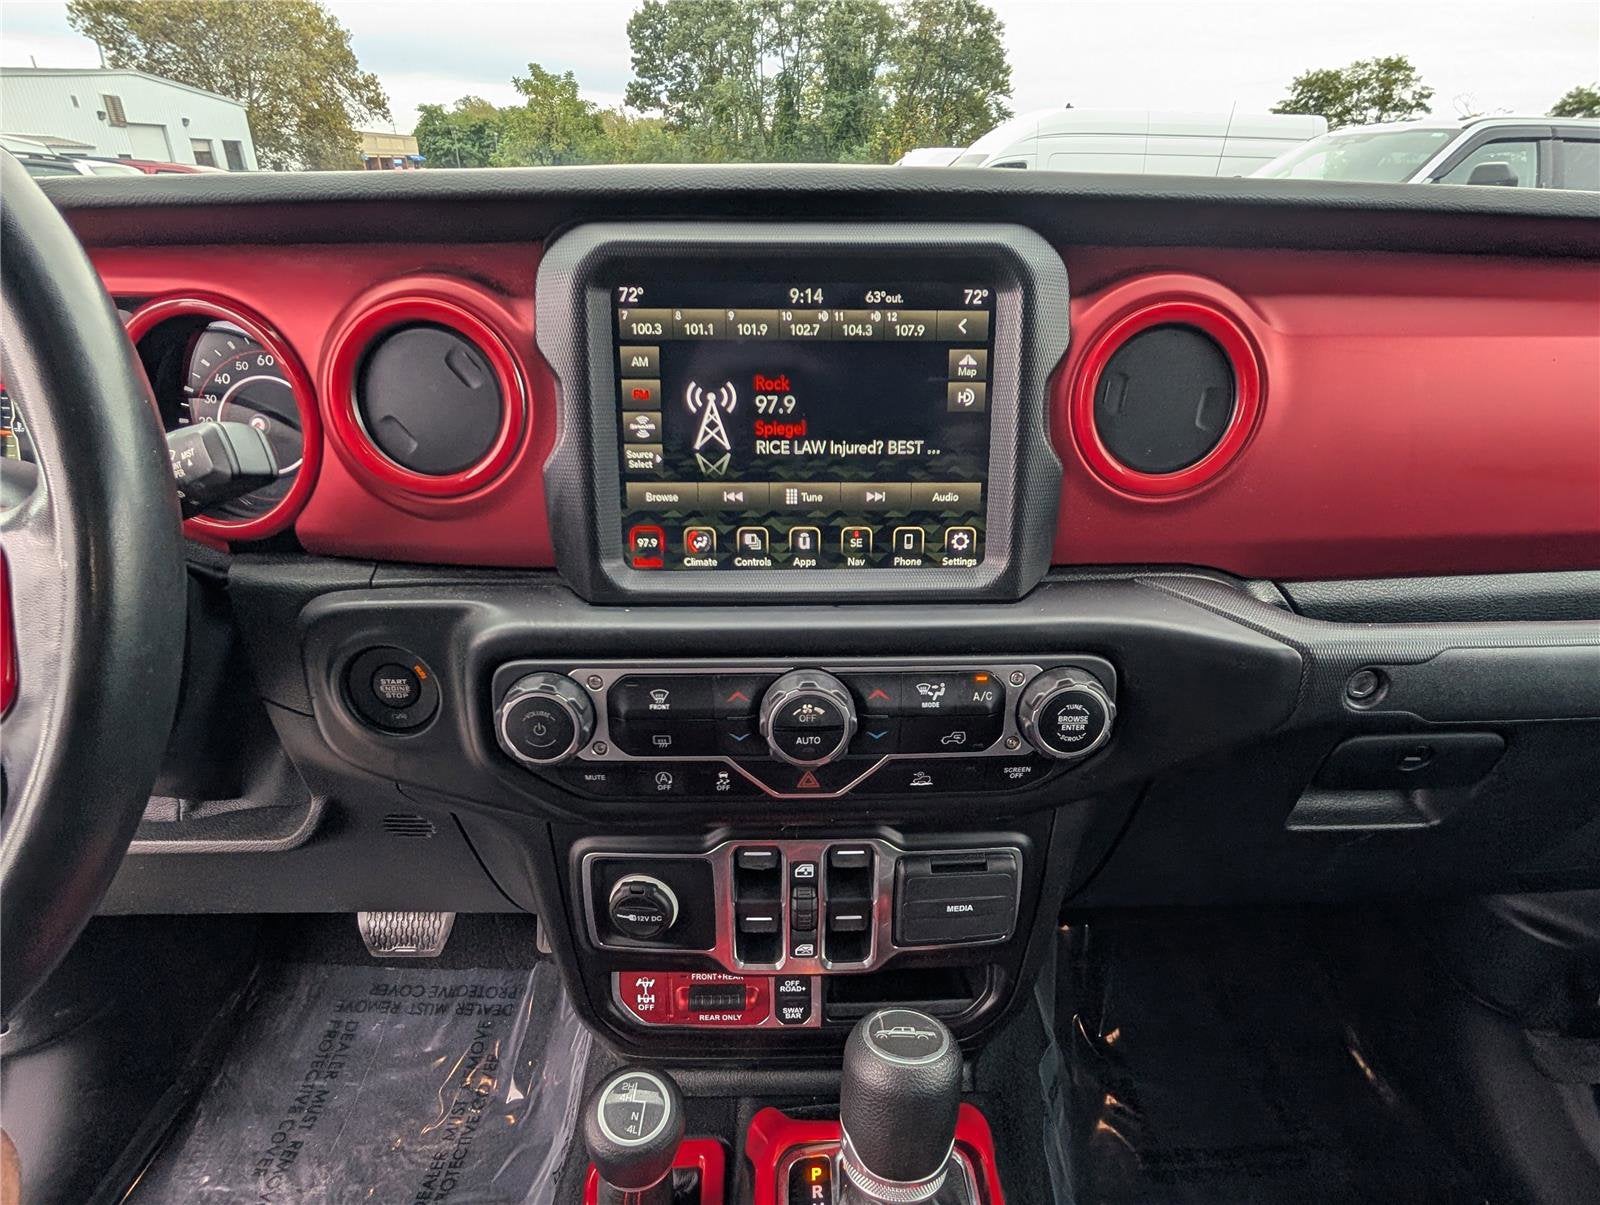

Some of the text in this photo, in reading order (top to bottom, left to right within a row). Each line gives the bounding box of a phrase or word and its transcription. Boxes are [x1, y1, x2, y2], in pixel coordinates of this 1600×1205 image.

[618, 287, 644, 302] 72°
[789, 287, 823, 304] 9:14
[963, 288, 988, 305] 72°
[621, 311, 628, 320] 7
[674, 311, 682, 321] 8
[727, 311, 735, 321] 9
[781, 311, 793, 321] 10
[834, 311, 844, 322] 11
[886, 311, 898, 322] 12
[631, 323, 662, 336] 100.3
[683, 323, 714, 336] 101.1
[737, 323, 768, 336] 101.9
[790, 323, 821, 336] 102.7
[842, 324, 873, 337] 104.3
[894, 324, 926, 337] 107.9
[235, 361, 249, 371] 50
[257, 354, 274, 366] 60
[630, 355, 650, 368] AM
[214, 373, 231, 384] 40
[957, 366, 977, 379] Map
[754, 374, 791, 391] Rock
[204, 394, 217, 404] 30
[755, 395, 796, 414] 97.9
[754, 419, 807, 439] Spiegel
[625, 449, 654, 459] Source
[756, 439, 791, 455] RICE
[794, 439, 827, 455] LAW
[830, 439, 884, 457] Injured?
[888, 439, 924, 455] BEST
[628, 459, 654, 469] Select
[645, 491, 679, 503] Browse
[800, 491, 823, 503] Tune
[931, 491, 959, 503] Audio
[636, 537, 658, 548] 97.9
[850, 538, 863, 548] SE
[683, 556, 718, 568] Climate
[734, 556, 772, 568] Controls
[792, 556, 817, 569] Apps
[847, 556, 866, 568] Nav
[893, 556, 923, 568] Phone
[941, 556, 977, 569] Settings
[972, 690, 993, 702] A/C
[648, 703, 670, 711] FRONT
[1066, 703, 1084, 711] TUNE
[798, 714, 817, 723] OFF
[1057, 715, 1089, 723] BROWSE
[795, 736, 821, 745] AUTO
[1003, 766, 1032, 774] SCREEN
[584, 773, 606, 781] MUTE
[946, 903, 974, 913] MEDIA
[637, 1003, 655, 1011] OFF
[621, 1082, 635, 1091] 2H
[630, 1111, 640, 1121] N
[626, 1124, 638, 1135] 4L
[430, 1114, 482, 1205] ROTECTIVE
[811, 1167, 822, 1181] P
[812, 1184, 824, 1199] R
